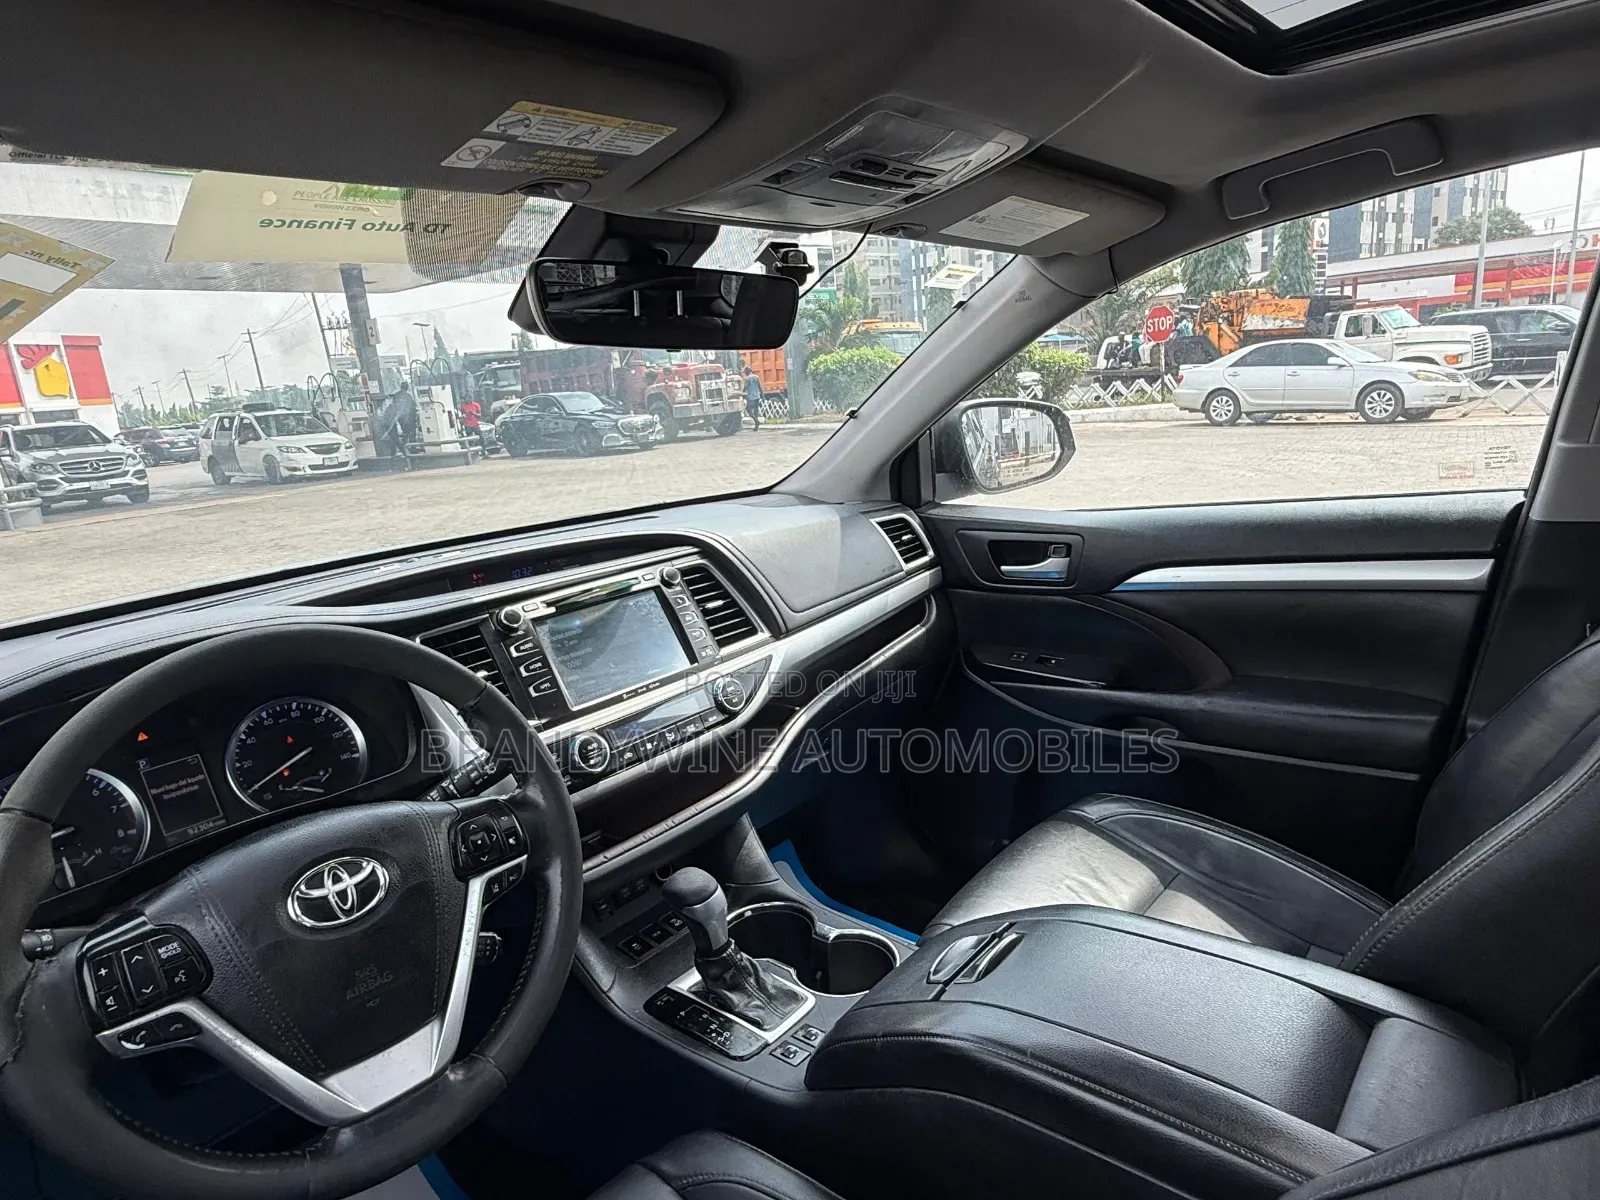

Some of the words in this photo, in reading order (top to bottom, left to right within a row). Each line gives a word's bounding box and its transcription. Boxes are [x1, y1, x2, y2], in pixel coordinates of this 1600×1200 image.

[294, 190, 332, 200] PEOPLE
[314, 203, 344, 211] VISION
[345, 205, 371, 213] ZERO
[1146, 315, 1173, 333] STOP
[369, 326, 376, 338] 2
[520, 642, 534, 651] AUDIO
[529, 661, 543, 670] HOME
[540, 682, 551, 690] APPS
[290, 710, 301, 718] 80
[263, 718, 274, 726] 60
[313, 715, 325, 724] 100
[332, 731, 344, 740] 120
[246, 736, 257, 745] 40
[340, 752, 352, 760] 140
[139, 760, 147, 769] P
[241, 760, 253, 768] 20
[92, 788, 100, 796] 6
[110, 805, 117, 814] 7
[117, 828, 125, 837] 8
[187, 821, 214, 836] 92304
[158, 941, 180, 954] MODE
[346, 970, 394, 1000] AIRBAG
